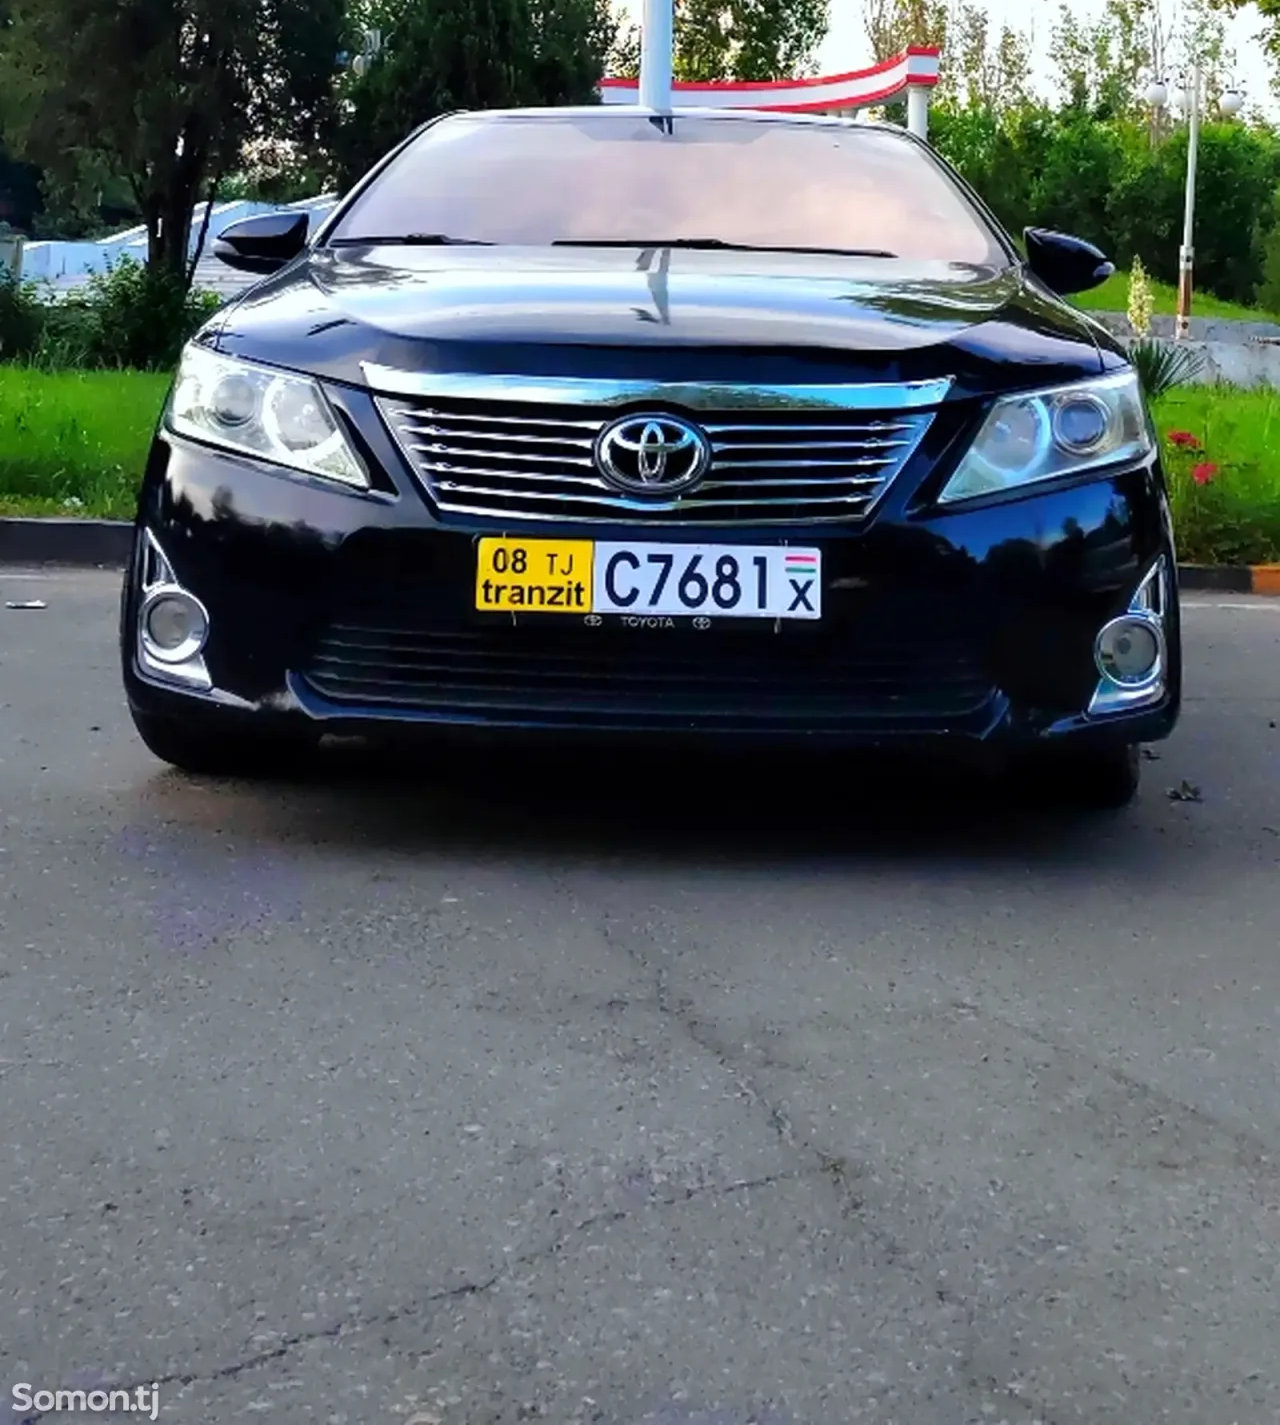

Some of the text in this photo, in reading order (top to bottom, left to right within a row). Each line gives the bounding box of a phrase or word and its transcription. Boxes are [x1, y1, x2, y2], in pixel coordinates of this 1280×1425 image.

[492, 547, 574, 576] 08 TJ
[482, 579, 585, 607] tranzit
[605, 550, 767, 609] C7681
[787, 578, 815, 612] X
[620, 616, 675, 629] TOYOTA
